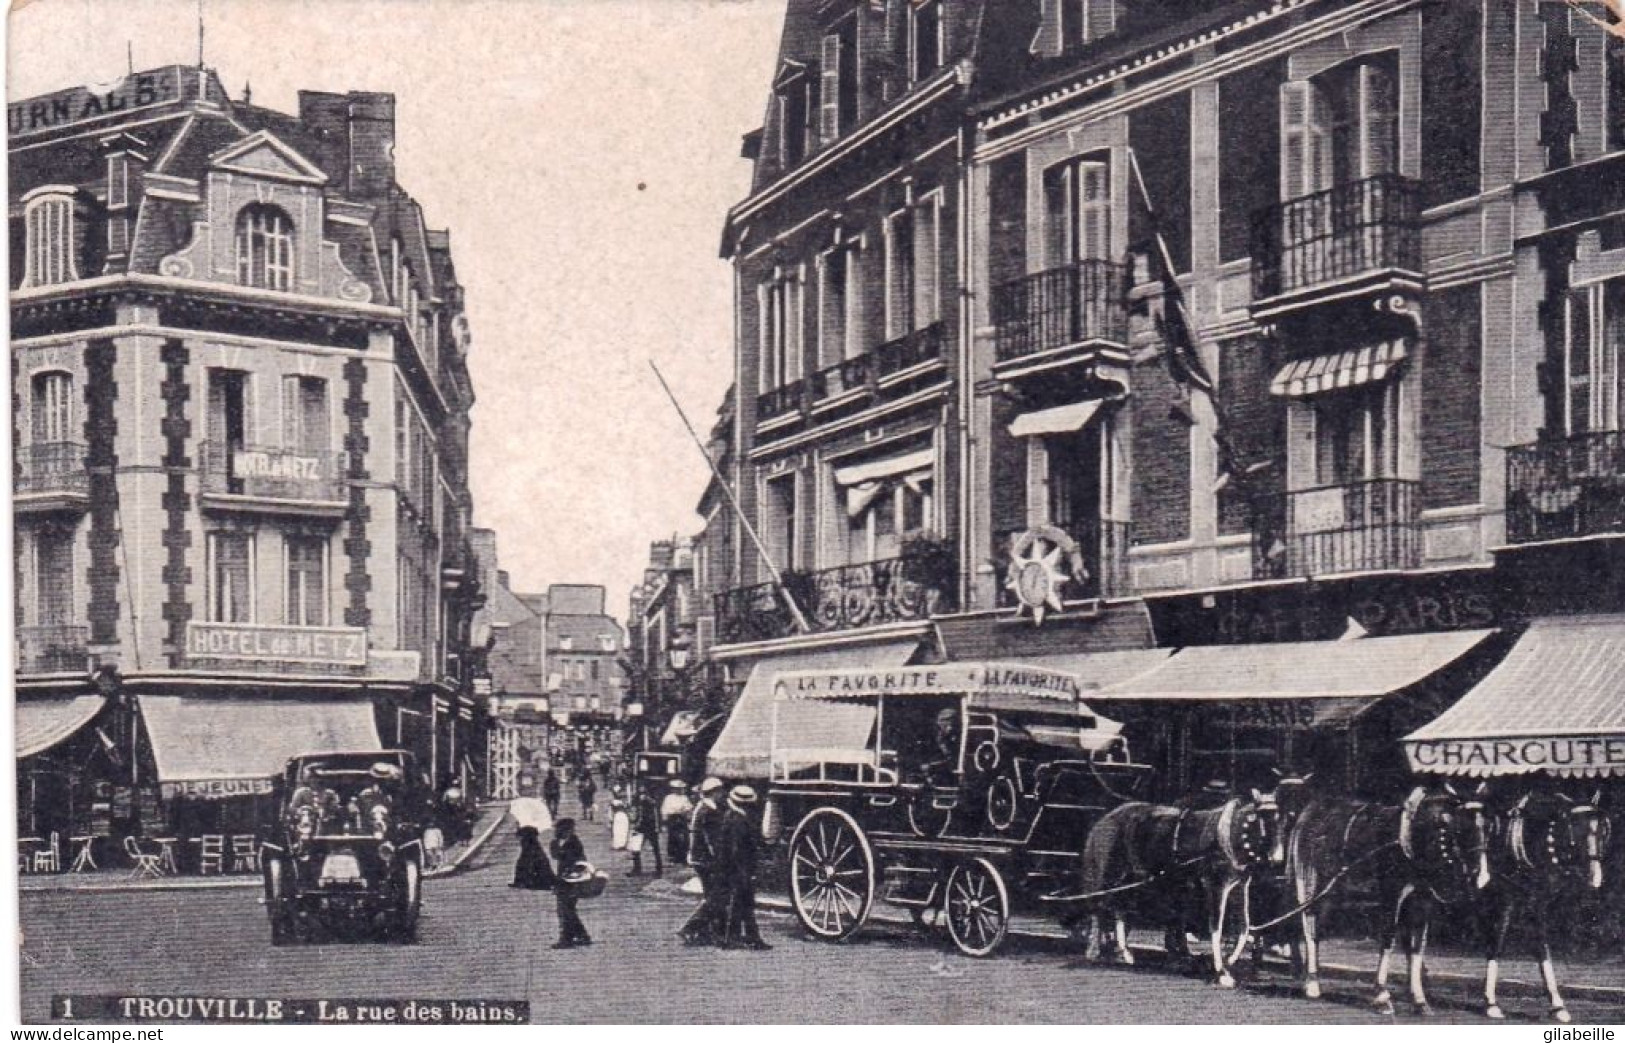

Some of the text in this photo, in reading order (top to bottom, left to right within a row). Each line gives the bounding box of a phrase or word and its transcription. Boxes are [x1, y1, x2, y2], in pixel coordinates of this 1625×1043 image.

[195, 629, 266, 654] HOTEL
[297, 633, 359, 658] METZ
[798, 675, 816, 691] LA
[1414, 740, 1625, 765] CHARCUTE
